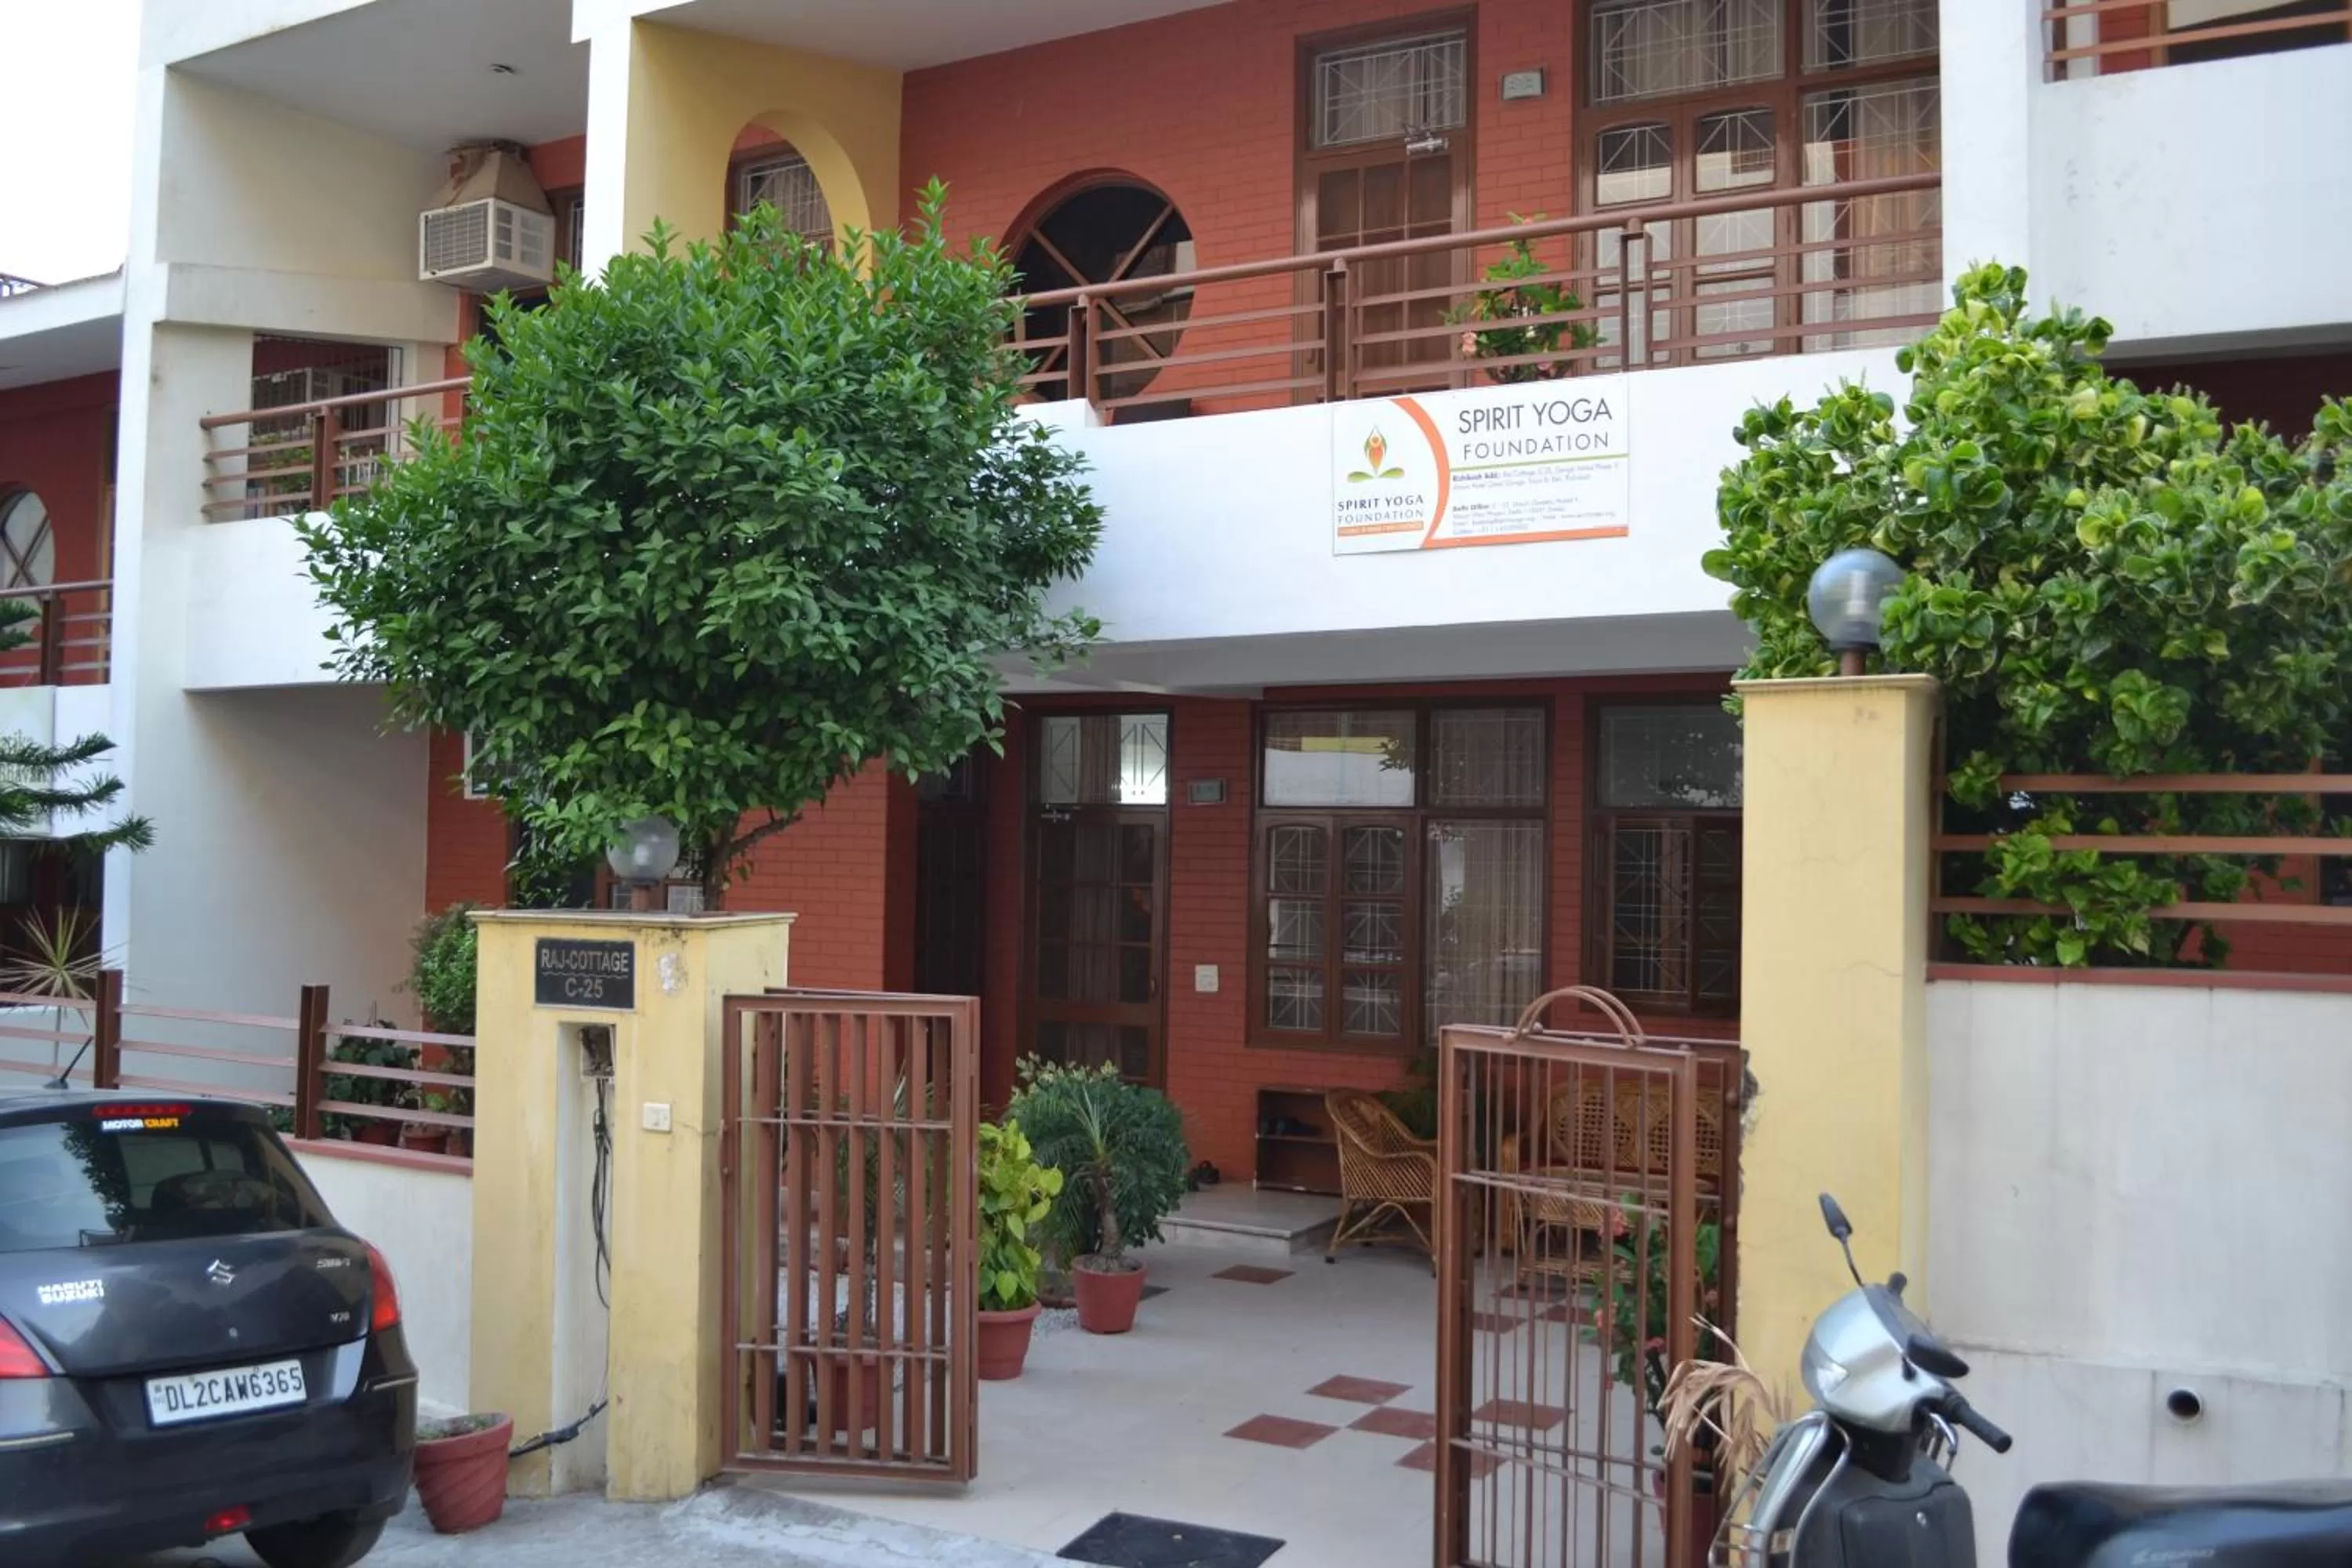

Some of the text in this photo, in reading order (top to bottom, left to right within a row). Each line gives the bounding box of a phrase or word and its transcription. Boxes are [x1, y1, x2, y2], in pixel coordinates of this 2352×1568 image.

[1458, 397, 1612, 434] SPIRIT YOGA
[1463, 432, 1609, 460] FOUNDATION
[1337, 508, 1424, 524] FOUNDATION
[1338, 494, 1424, 512] SPIRIT YOGA
[540, 947, 630, 973] RAJ-COTTAGE
[565, 977, 604, 999] C-25
[165, 1367, 303, 1412] DL2CAW6365
